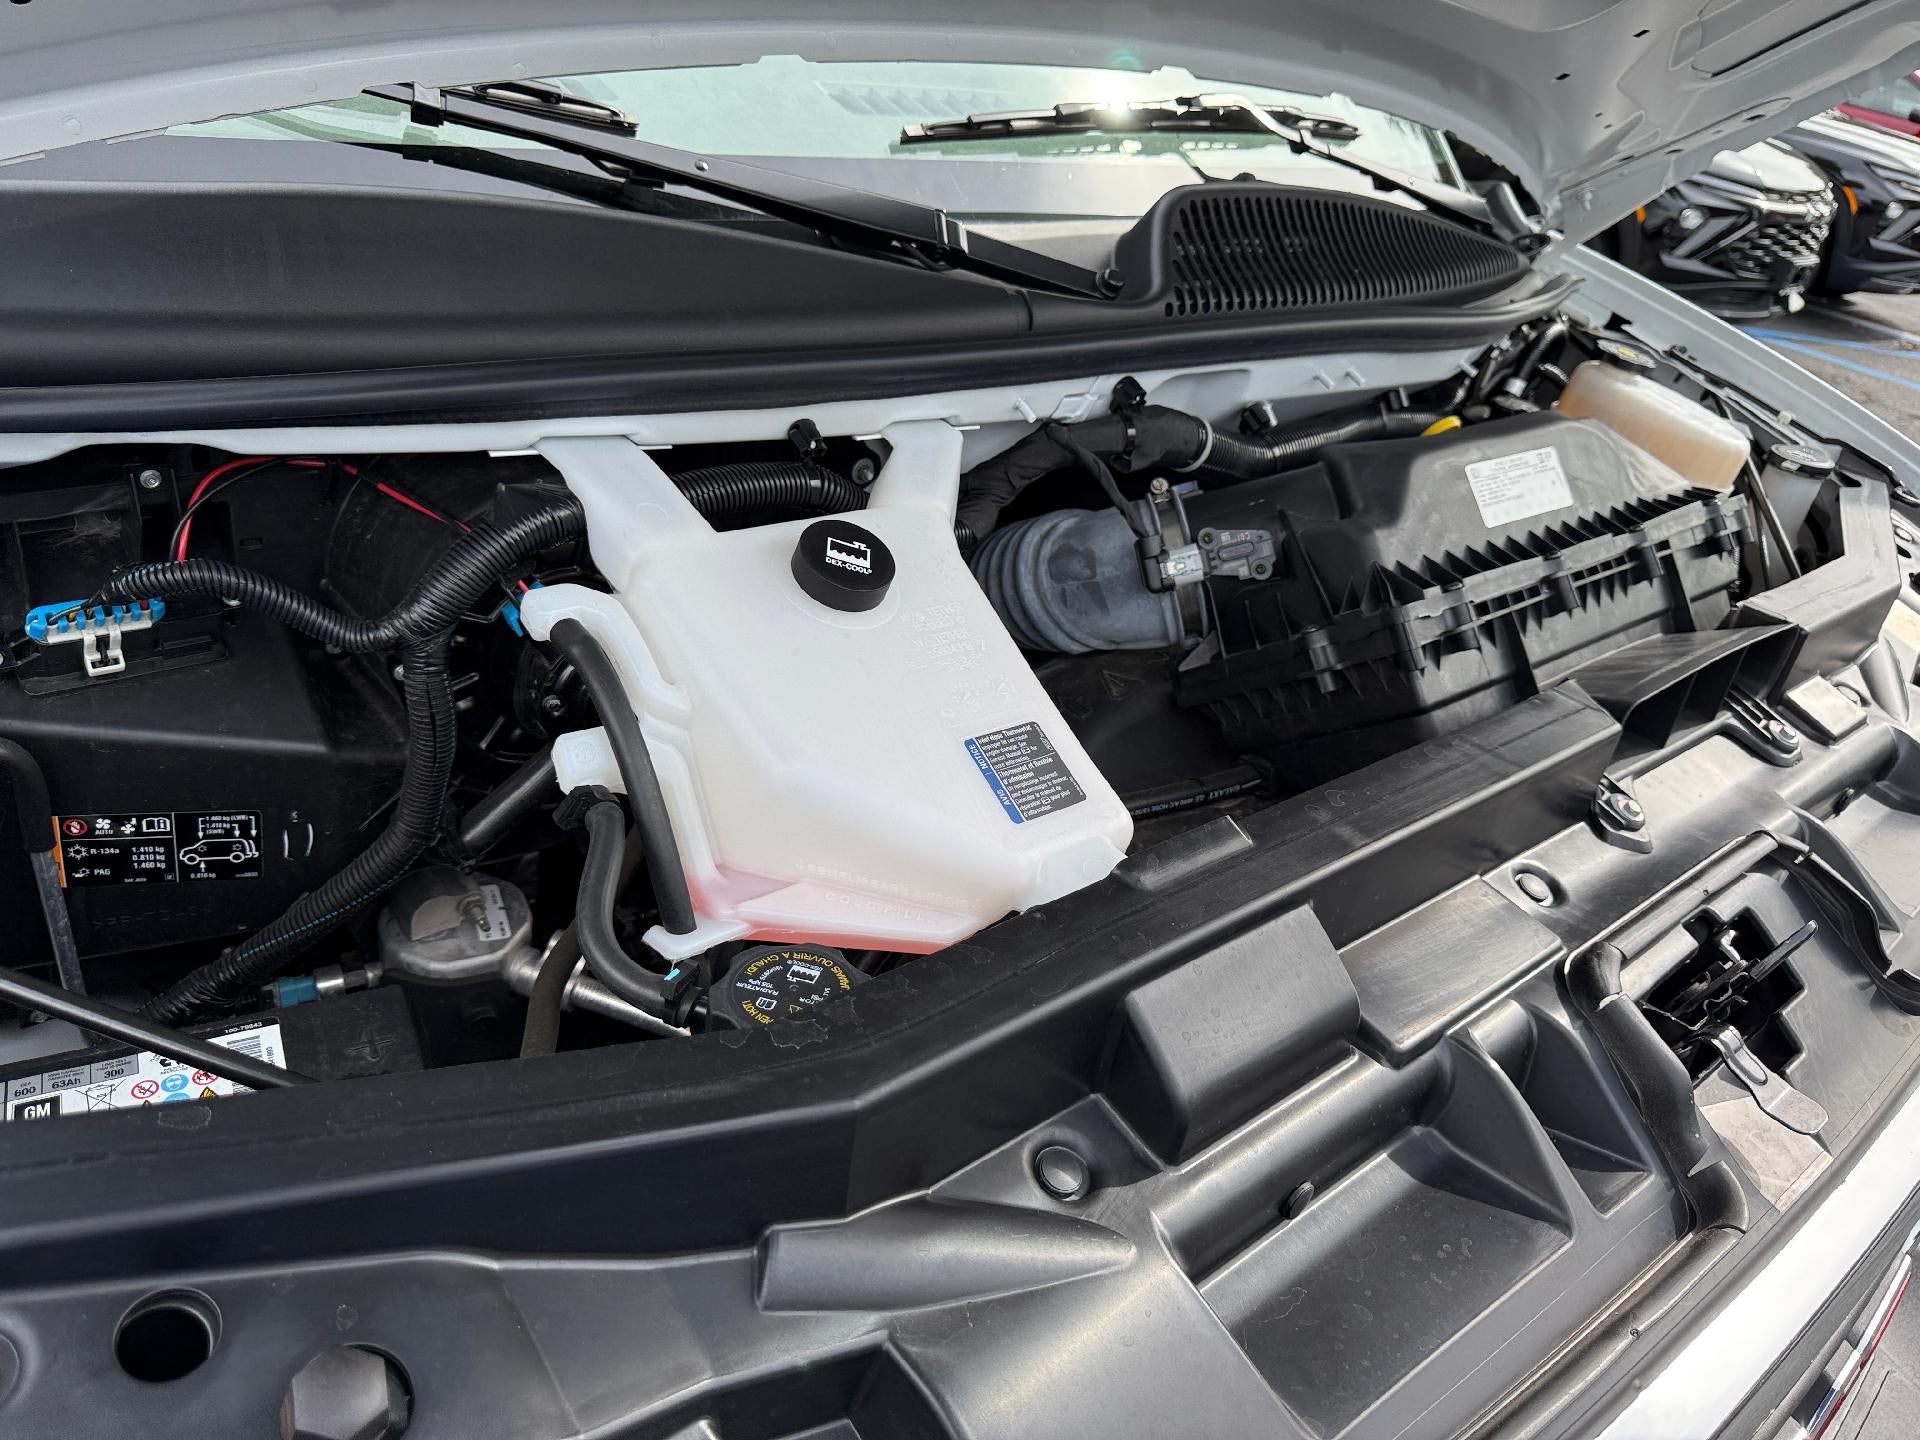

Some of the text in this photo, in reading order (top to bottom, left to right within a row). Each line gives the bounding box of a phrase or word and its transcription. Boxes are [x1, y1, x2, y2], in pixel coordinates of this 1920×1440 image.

[825, 556, 872, 575] DEX-COOL®
[968, 744, 988, 770] NOTICE
[996, 788, 1011, 806] AVIS
[90, 847, 120, 855] R-134a
[155, 845, 165, 854] kg
[132, 853, 166, 862] 0.810 kg
[133, 860, 166, 870] 1.460 kg
[94, 868, 111, 876] PAG
[745, 954, 779, 976] CHAUD!
[793, 952, 833, 968] OUVRIR
[736, 982, 779, 996] RADIATEUR
[741, 999, 760, 1015] HOT!
[103, 1067, 125, 1079] 300
[51, 1076, 82, 1089] 63Ah
[13, 1086, 37, 1098] 600
[23, 1103, 51, 1120] GM
